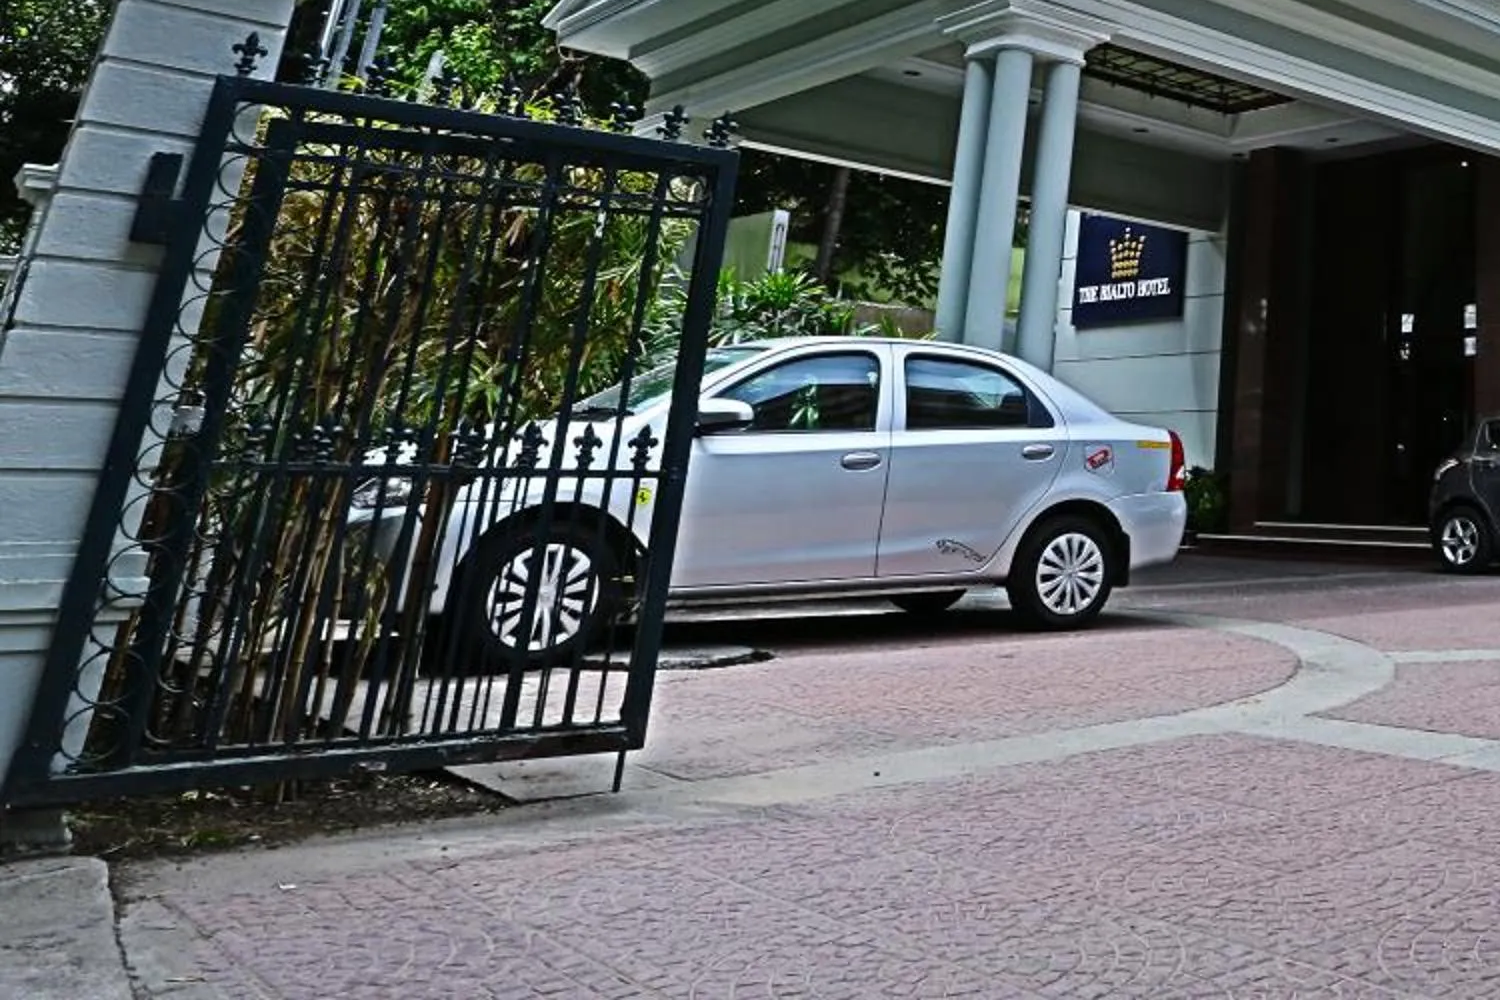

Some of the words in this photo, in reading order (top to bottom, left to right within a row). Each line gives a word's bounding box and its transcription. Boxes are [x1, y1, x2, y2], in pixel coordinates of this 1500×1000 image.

[1079, 286, 1099, 303] THE
[1100, 282, 1135, 301] RIALTO
[1137, 277, 1170, 297] HOTEL
